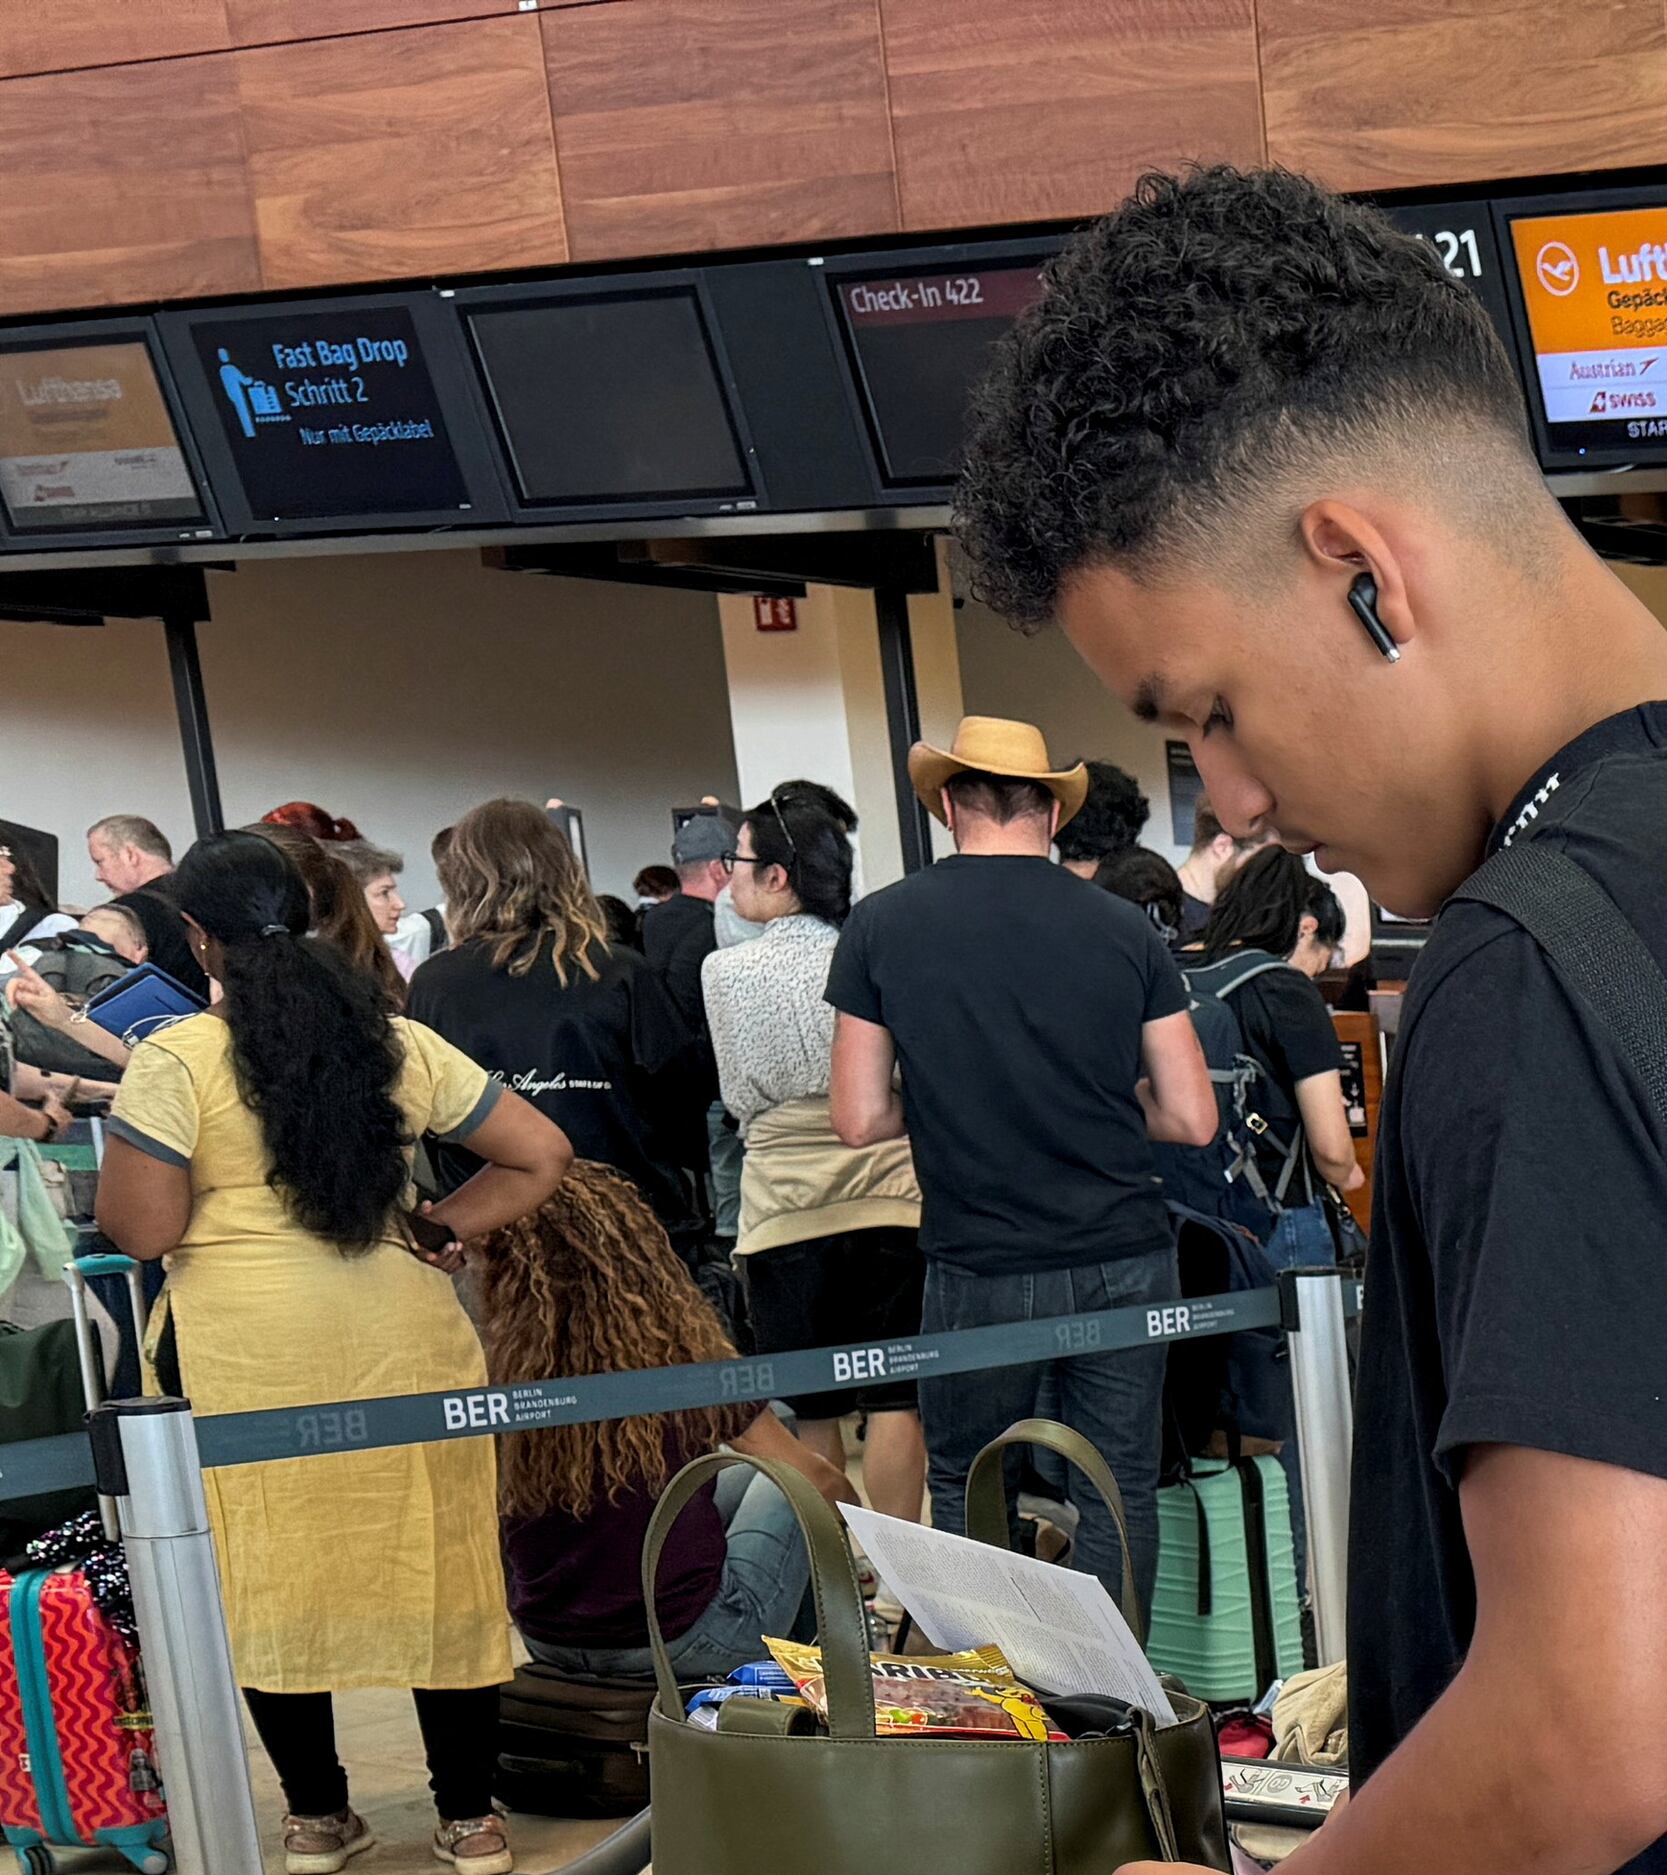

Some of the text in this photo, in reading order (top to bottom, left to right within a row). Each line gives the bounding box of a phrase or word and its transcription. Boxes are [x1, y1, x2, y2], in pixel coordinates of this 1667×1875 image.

[1416, 229, 1482, 278] 21
[850, 278, 984, 313] Check-In 422
[272, 336, 409, 372] Fast Bag Drop
[1569, 358, 1637, 381] Austrian
[284, 375, 370, 407] Schritt 2
[299, 427, 326, 446] Nur
[328, 423, 353, 444] mit
[1146, 1305, 1191, 1337] BER
[832, 1347, 887, 1383] BER
[512, 1387, 543, 1400] BERLIN
[513, 1395, 578, 1411] BRANDENBURG
[443, 1392, 511, 1431] BER
[515, 1409, 552, 1423] AIRPORT
